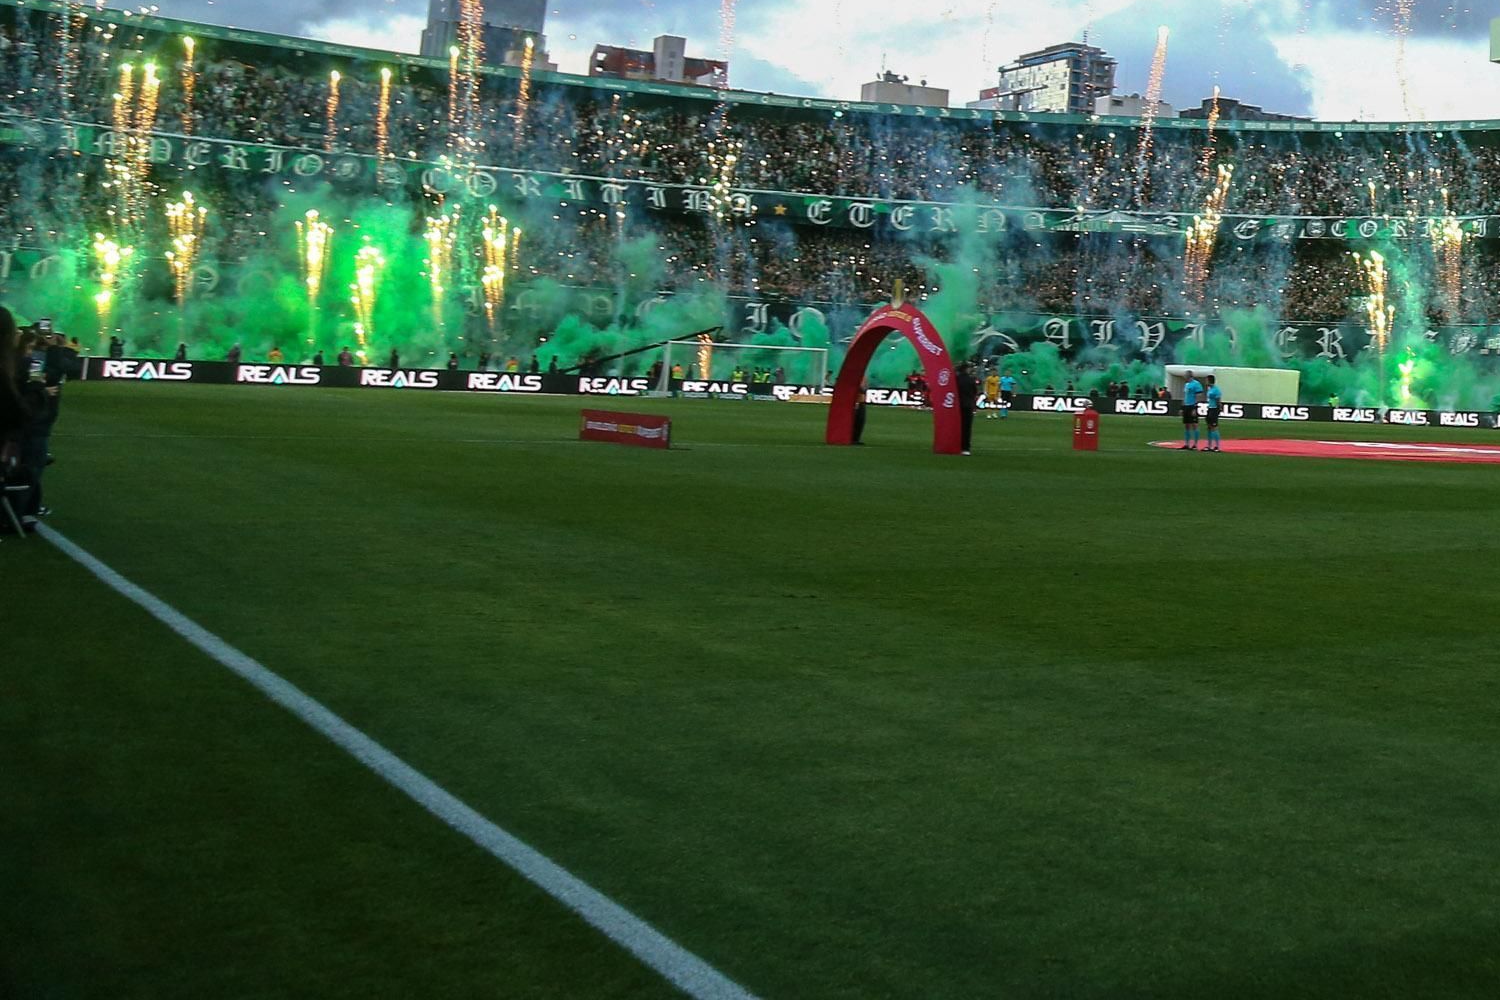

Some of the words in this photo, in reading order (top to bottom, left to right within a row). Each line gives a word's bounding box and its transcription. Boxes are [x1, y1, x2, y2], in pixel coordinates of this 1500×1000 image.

[103, 360, 192, 380] REALS
[237, 365, 320, 384] REALS
[360, 369, 439, 388] REALS
[467, 373, 542, 392] REALS
[1116, 400, 1168, 414] REALS
[1262, 405, 1309, 420] REALS
[1333, 408, 1375, 422] REALS
[1390, 410, 1427, 425] REALS
[1440, 412, 1479, 427] REALS
